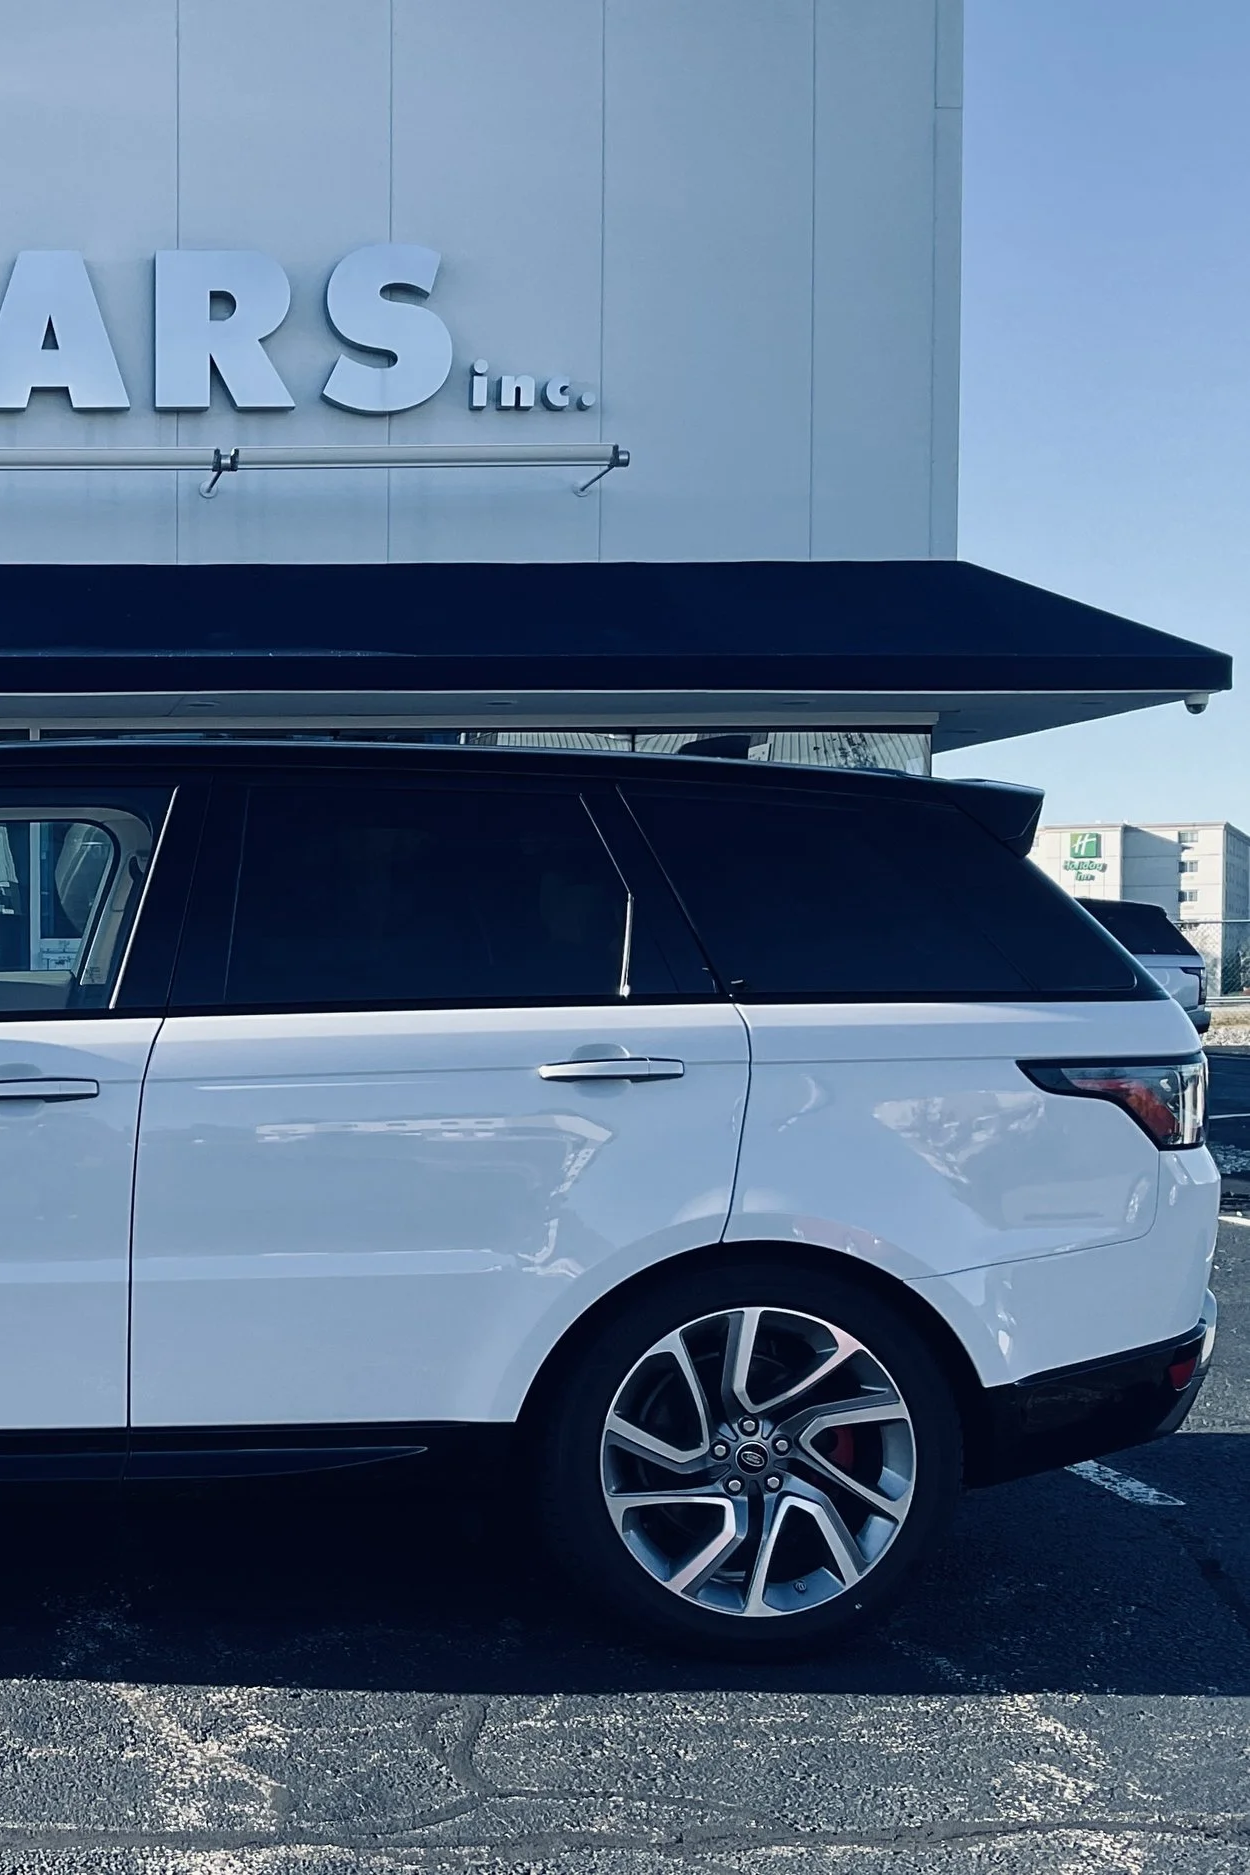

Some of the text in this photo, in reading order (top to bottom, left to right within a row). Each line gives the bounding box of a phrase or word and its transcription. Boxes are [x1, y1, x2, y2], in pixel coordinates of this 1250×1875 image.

[469, 358, 597, 412] inc.
[1062, 860, 1106, 872] Holiday
[1075, 870, 1094, 881] Inn
